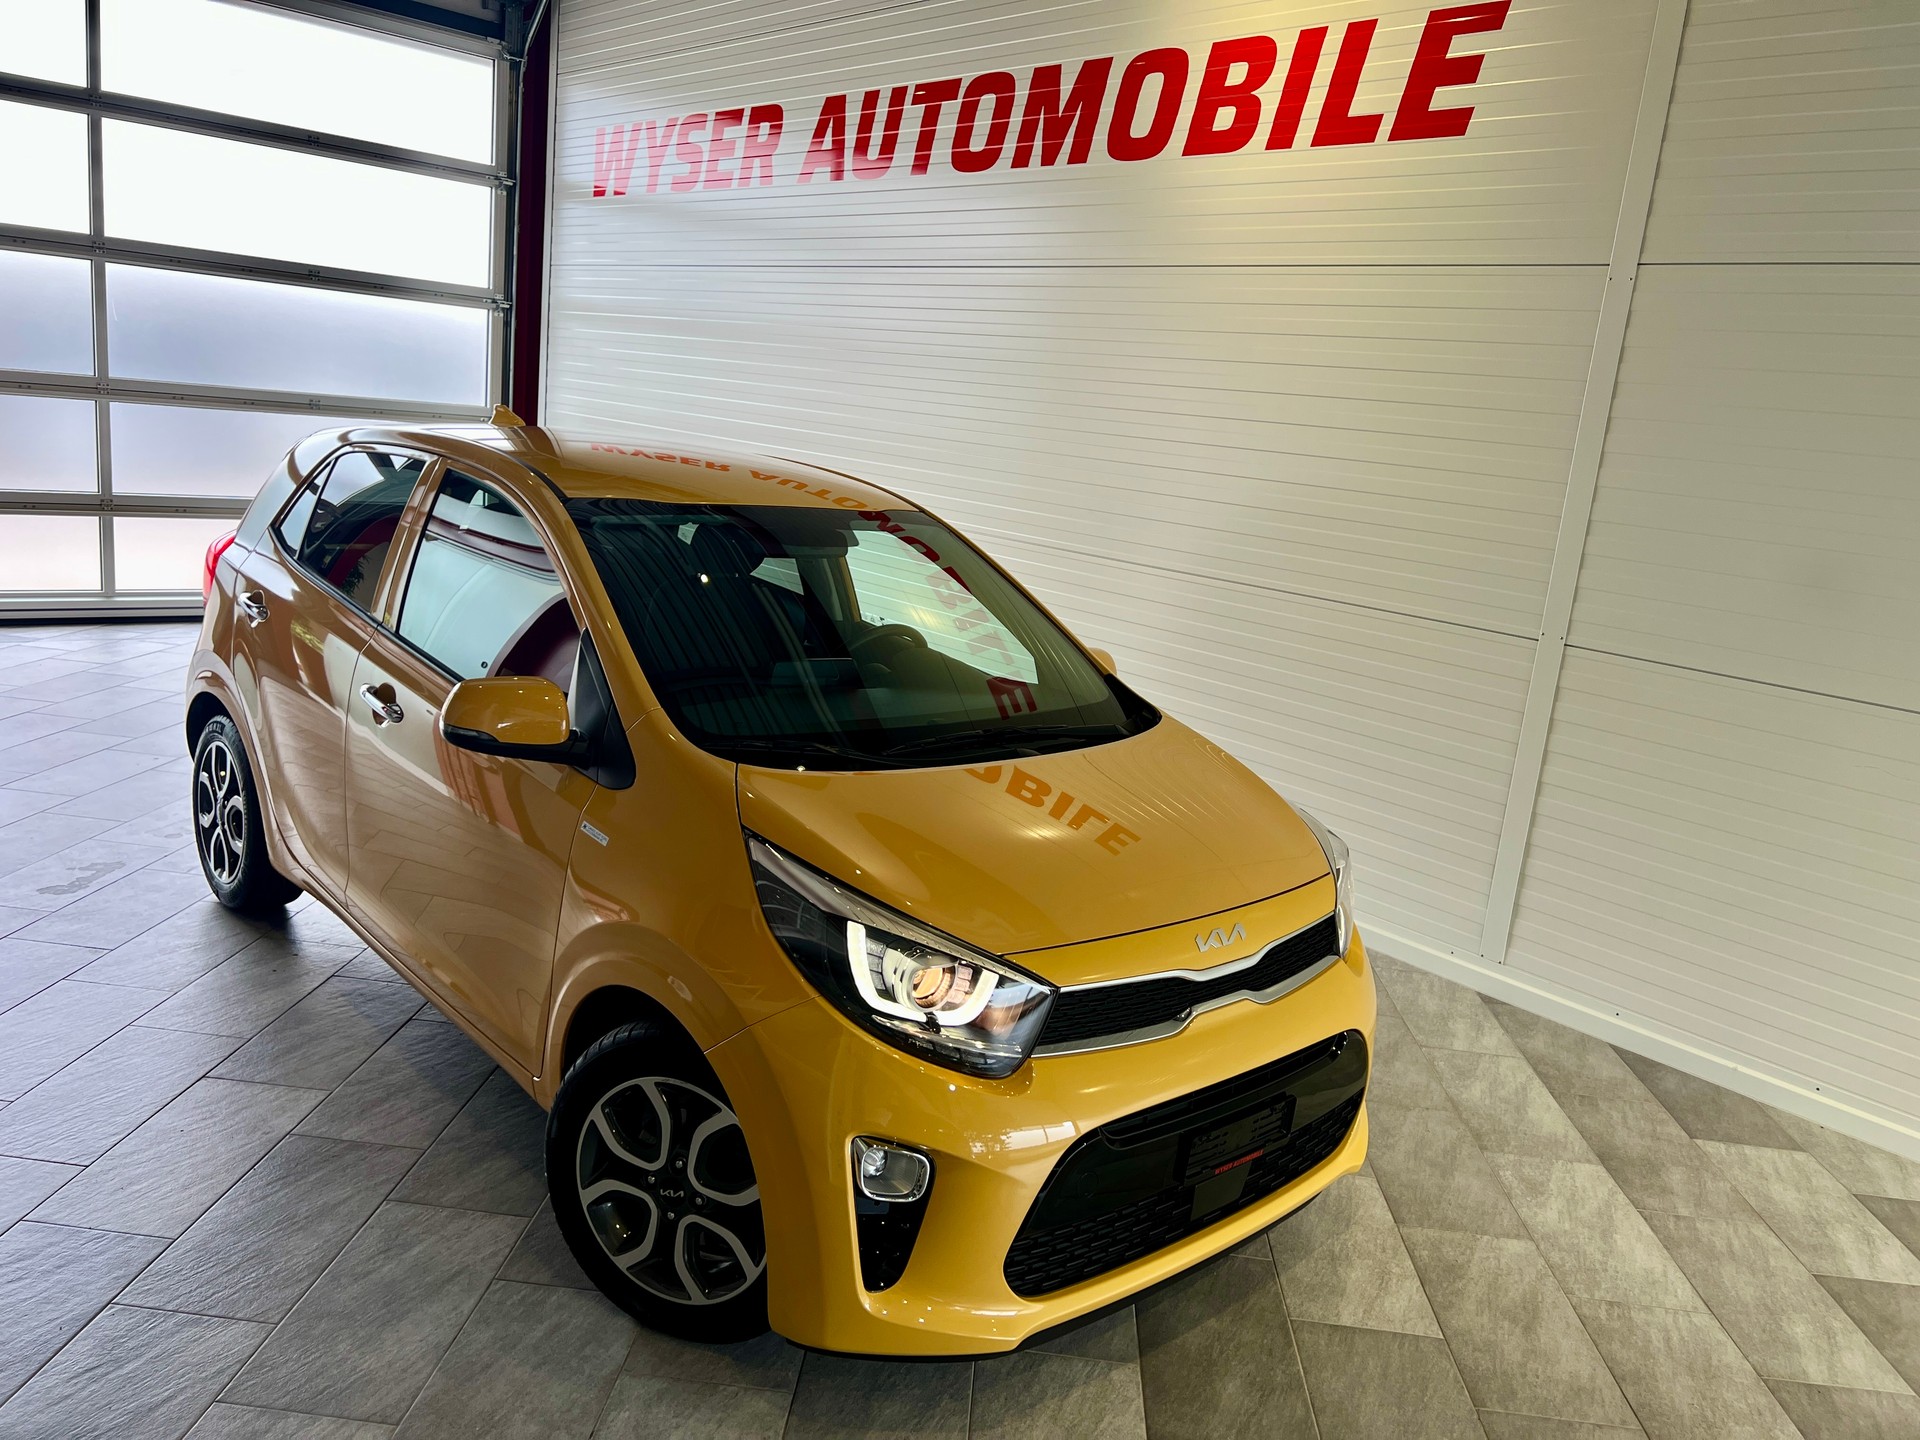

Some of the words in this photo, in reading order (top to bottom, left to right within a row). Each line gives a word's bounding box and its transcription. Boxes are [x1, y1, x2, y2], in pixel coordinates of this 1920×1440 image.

[592, 103, 785, 198] WYSER
[796, 0, 1513, 184] AUTOMOBILE
[1195, 923, 1247, 953] KIA
[660, 1188, 685, 1198] KIA
